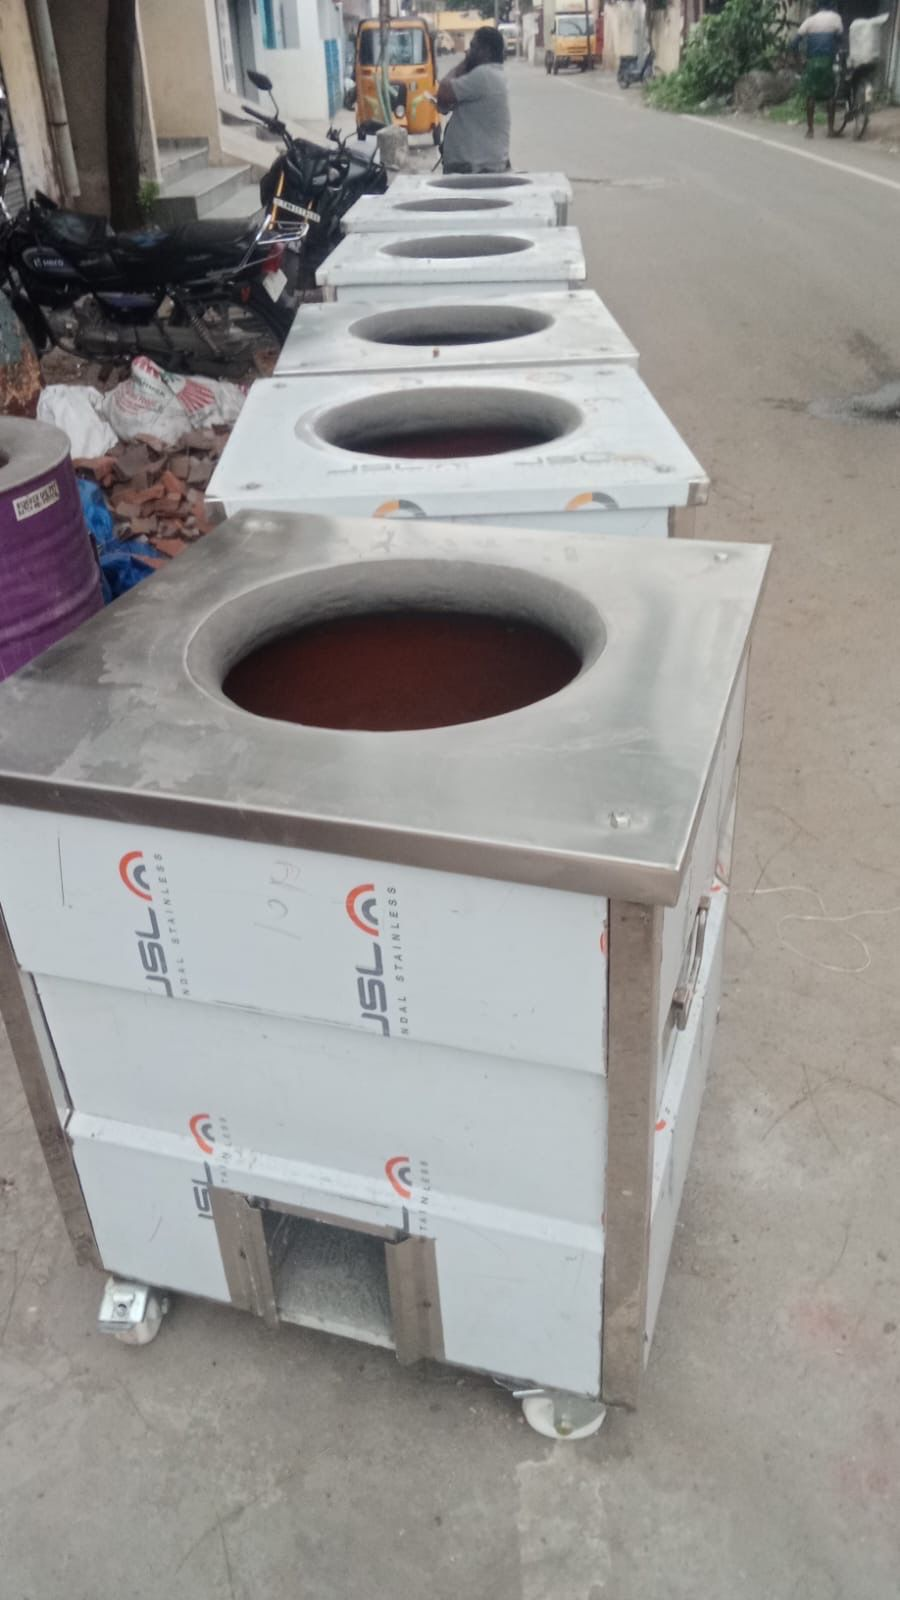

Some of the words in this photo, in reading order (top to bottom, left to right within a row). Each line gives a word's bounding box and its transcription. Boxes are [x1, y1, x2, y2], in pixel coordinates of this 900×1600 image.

[153, 852, 181, 945] STAINLESS
[386, 886, 405, 983] STAINLESS
[134, 906, 174, 998] JSL
[355, 942, 391, 1038] JSL
[399, 996, 410, 1035] NDAL
